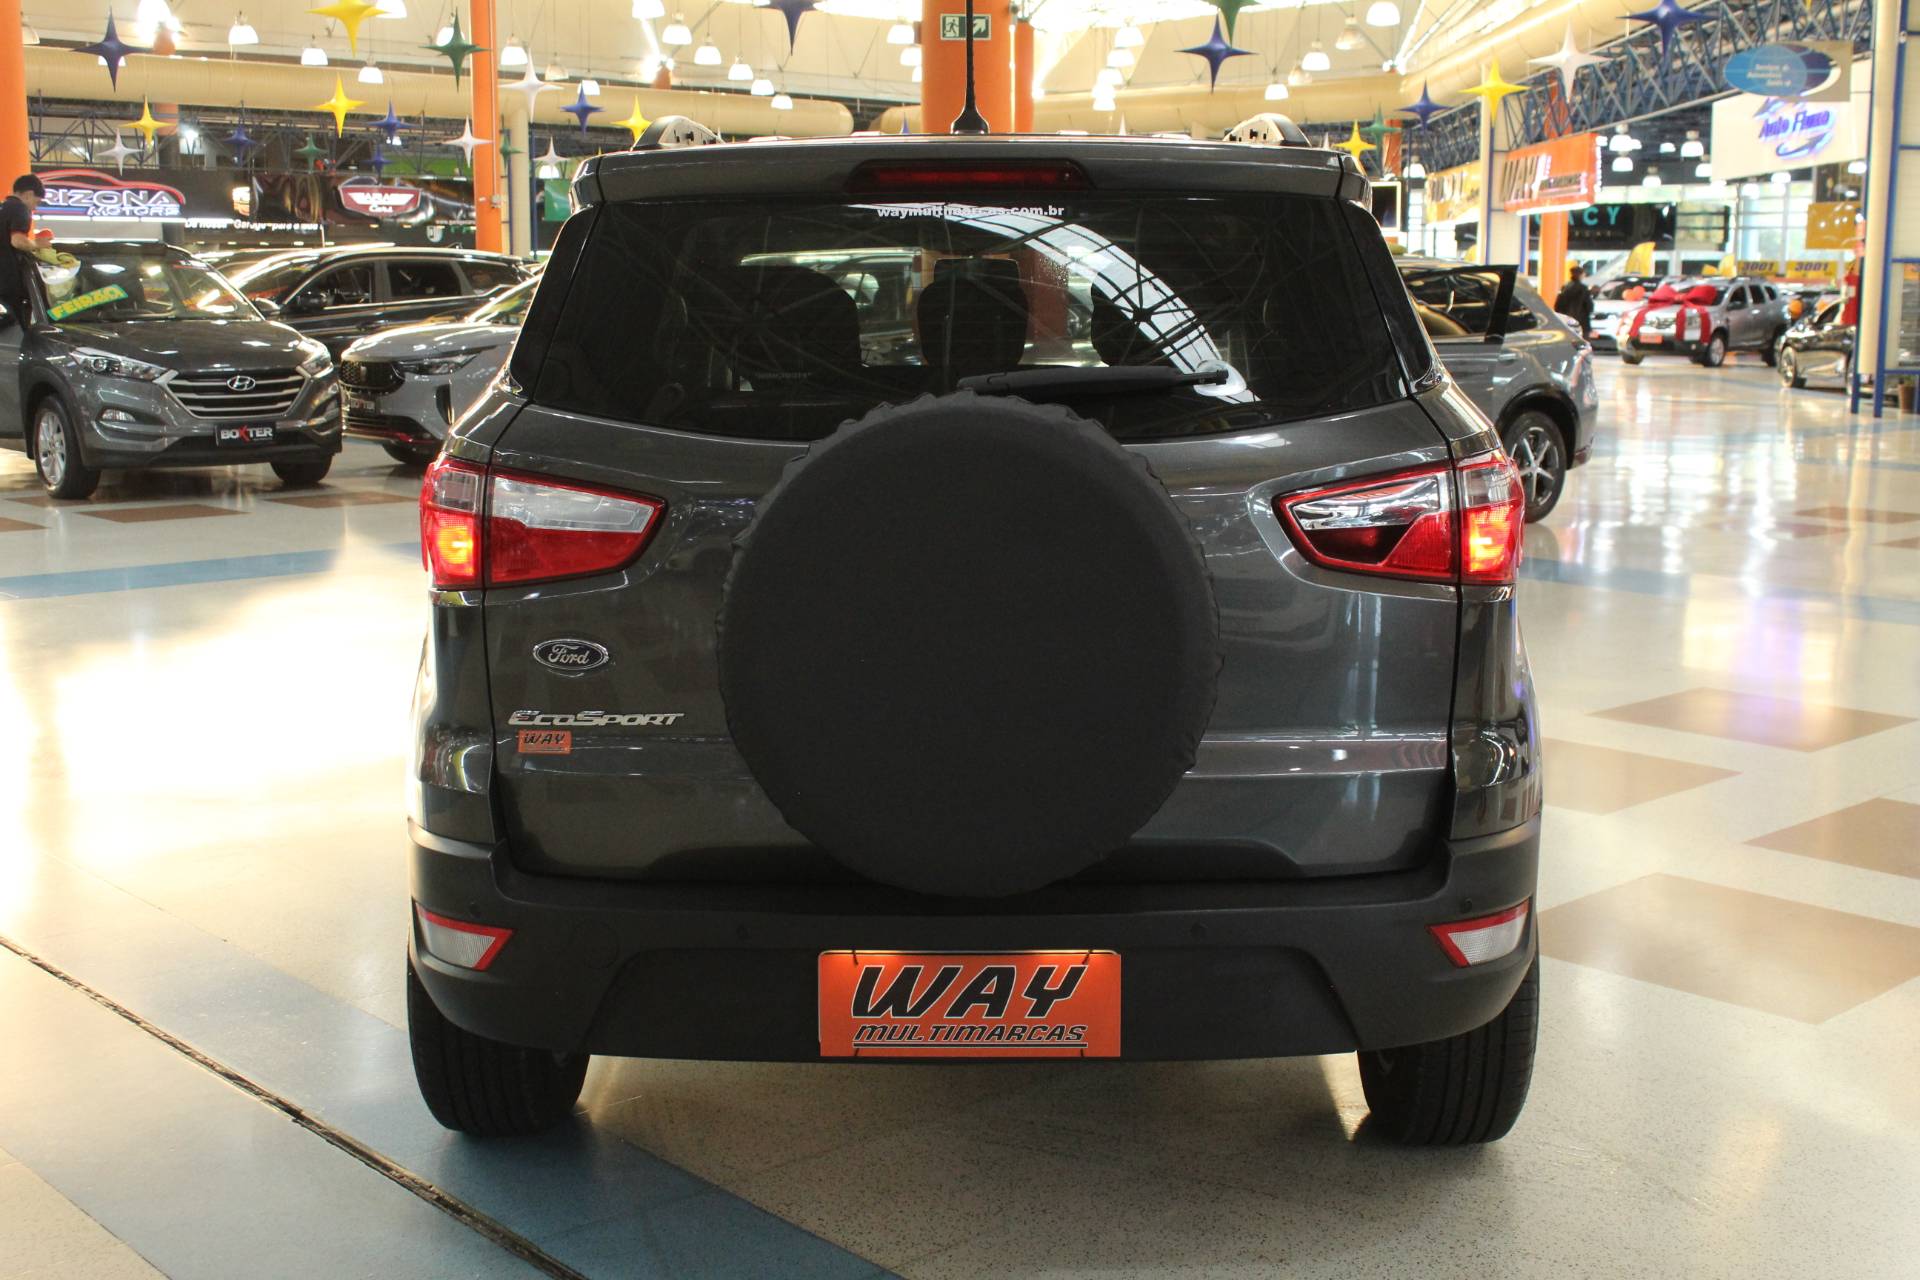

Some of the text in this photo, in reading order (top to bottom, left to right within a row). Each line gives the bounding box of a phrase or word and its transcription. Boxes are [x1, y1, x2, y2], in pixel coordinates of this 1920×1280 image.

[43, 189, 179, 206] RIZONA
[87, 204, 180, 216] MOTORS
[877, 204, 1065, 219] waymultimarcas.com.br
[1742, 261, 1775, 272] 3001
[1795, 261, 1830, 272] 3001
[220, 425, 274, 444] BOXTER
[548, 643, 590, 664] Ford
[524, 733, 566, 744] WAY
[851, 965, 1088, 1019] WAY
[854, 1024, 1088, 1042] MULTIMARCAS
